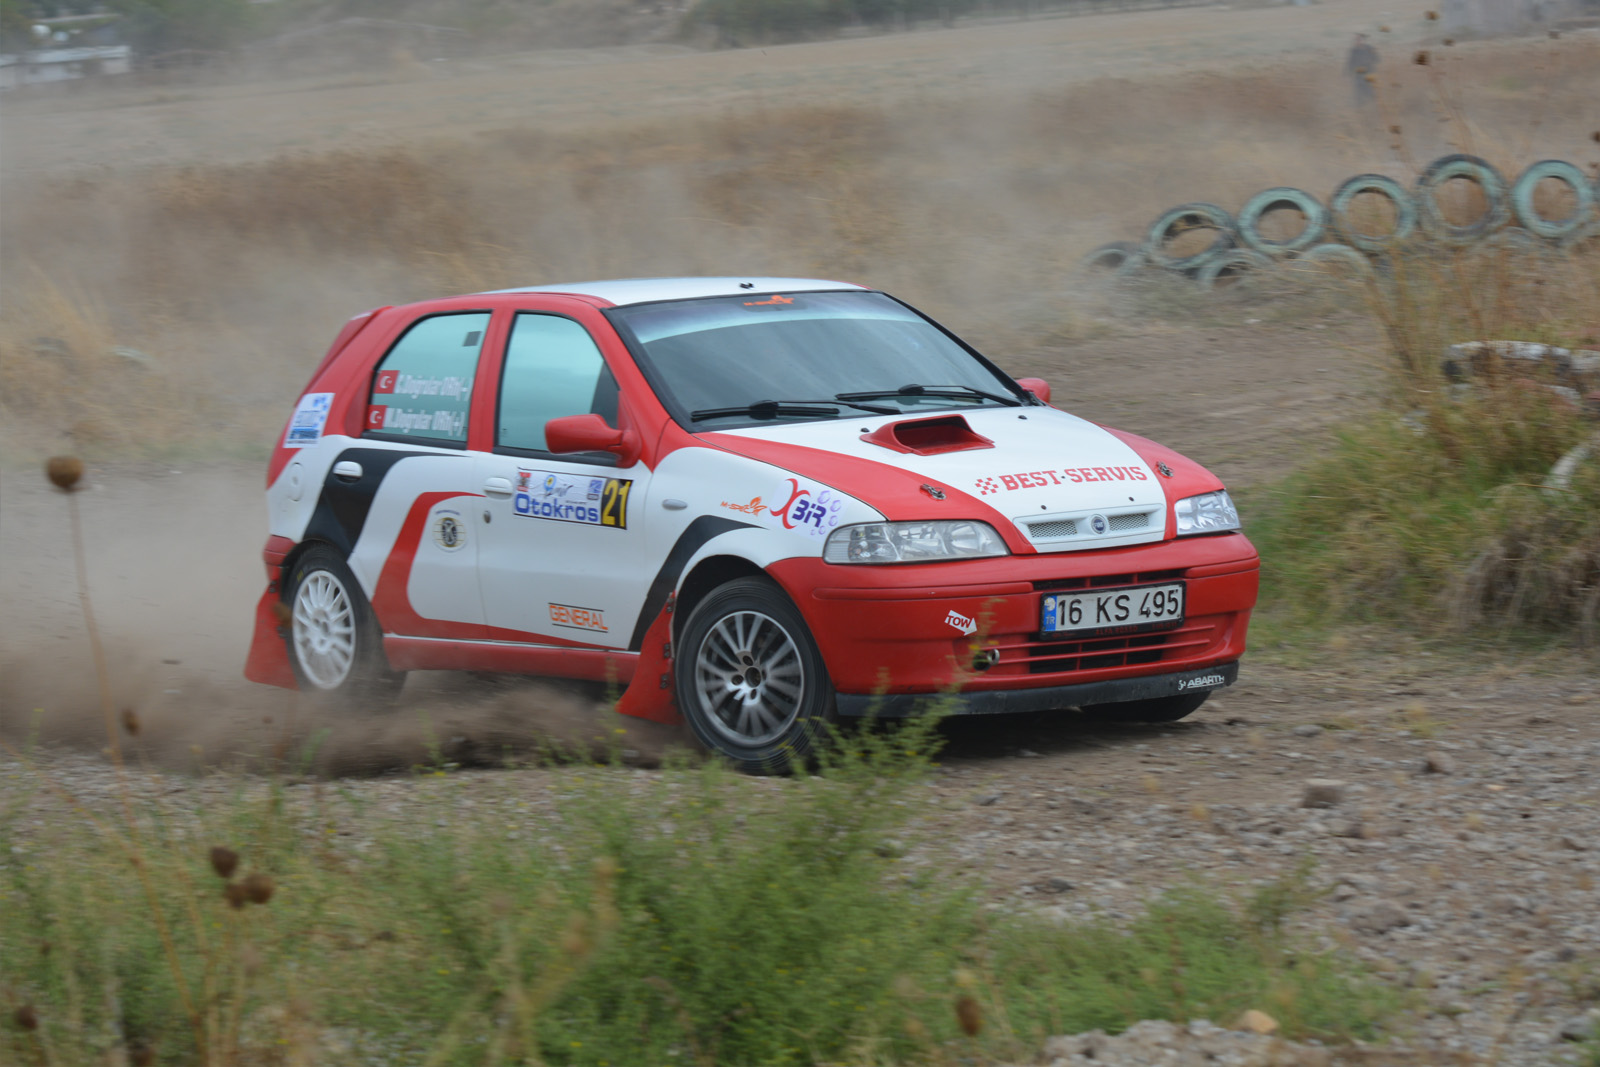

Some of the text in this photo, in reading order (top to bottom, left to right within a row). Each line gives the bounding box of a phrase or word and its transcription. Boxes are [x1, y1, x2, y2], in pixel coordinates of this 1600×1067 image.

[999, 466, 1148, 491] BEST SERVIS
[515, 493, 599, 522] Otokros
[602, 479, 631, 527] 21
[549, 604, 609, 630] GENERAL
[1058, 588, 1179, 626] 16 KS 495
[946, 614, 972, 629] TOW
[1187, 675, 1225, 687] ABARTH
